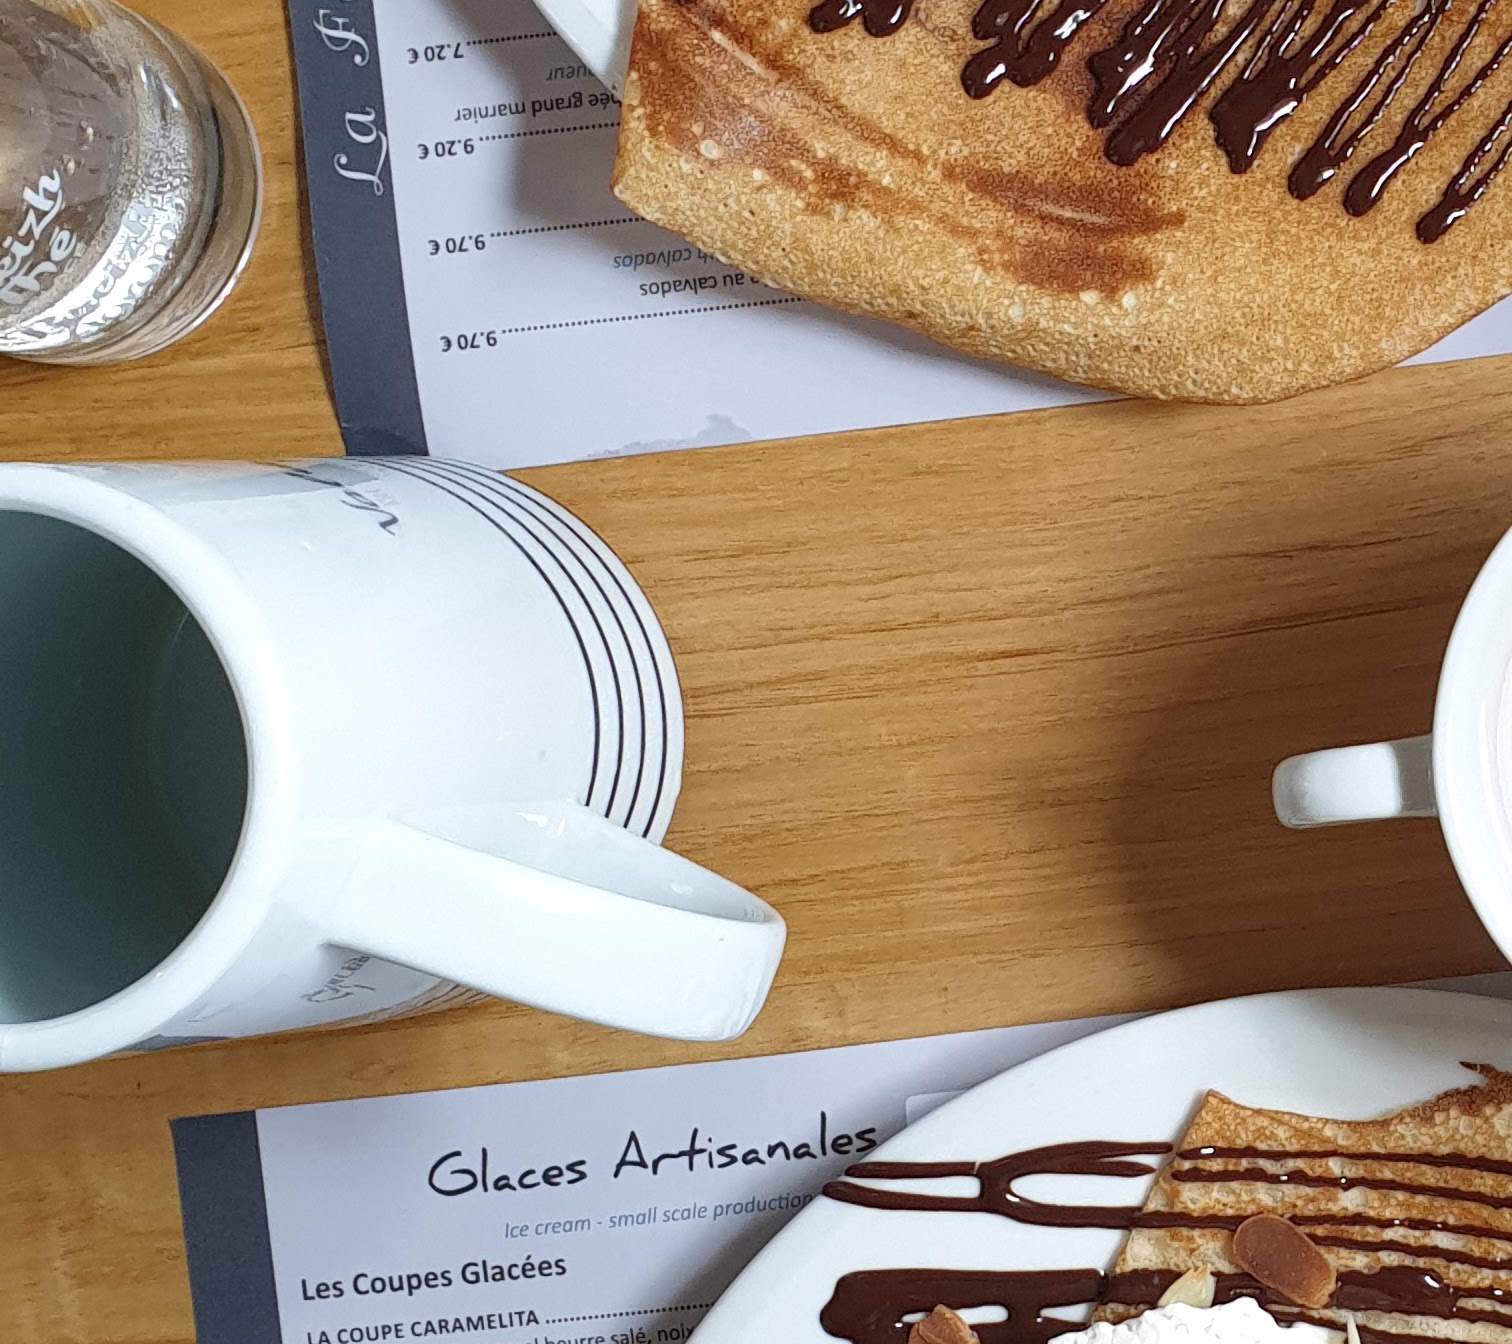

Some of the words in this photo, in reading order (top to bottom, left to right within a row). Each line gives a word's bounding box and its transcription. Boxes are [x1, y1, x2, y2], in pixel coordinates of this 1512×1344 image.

[334, 105, 389, 196] La
[427, 1147, 588, 1197] Glaces
[613, 1112, 877, 1178] Artisanales
[504, 1222, 530, 1239] Ice
[534, 1218, 591, 1236] cream
[608, 1206, 658, 1229] small
[662, 1202, 708, 1223] scale
[712, 1192, 814, 1222] production
[301, 1278, 345, 1301] Les
[352, 1269, 453, 1297] Coupes
[461, 1254, 567, 1285] Glacées
[336, 1322, 405, 1344] COUPE
[410, 1309, 540, 1337] CARAMELITA
